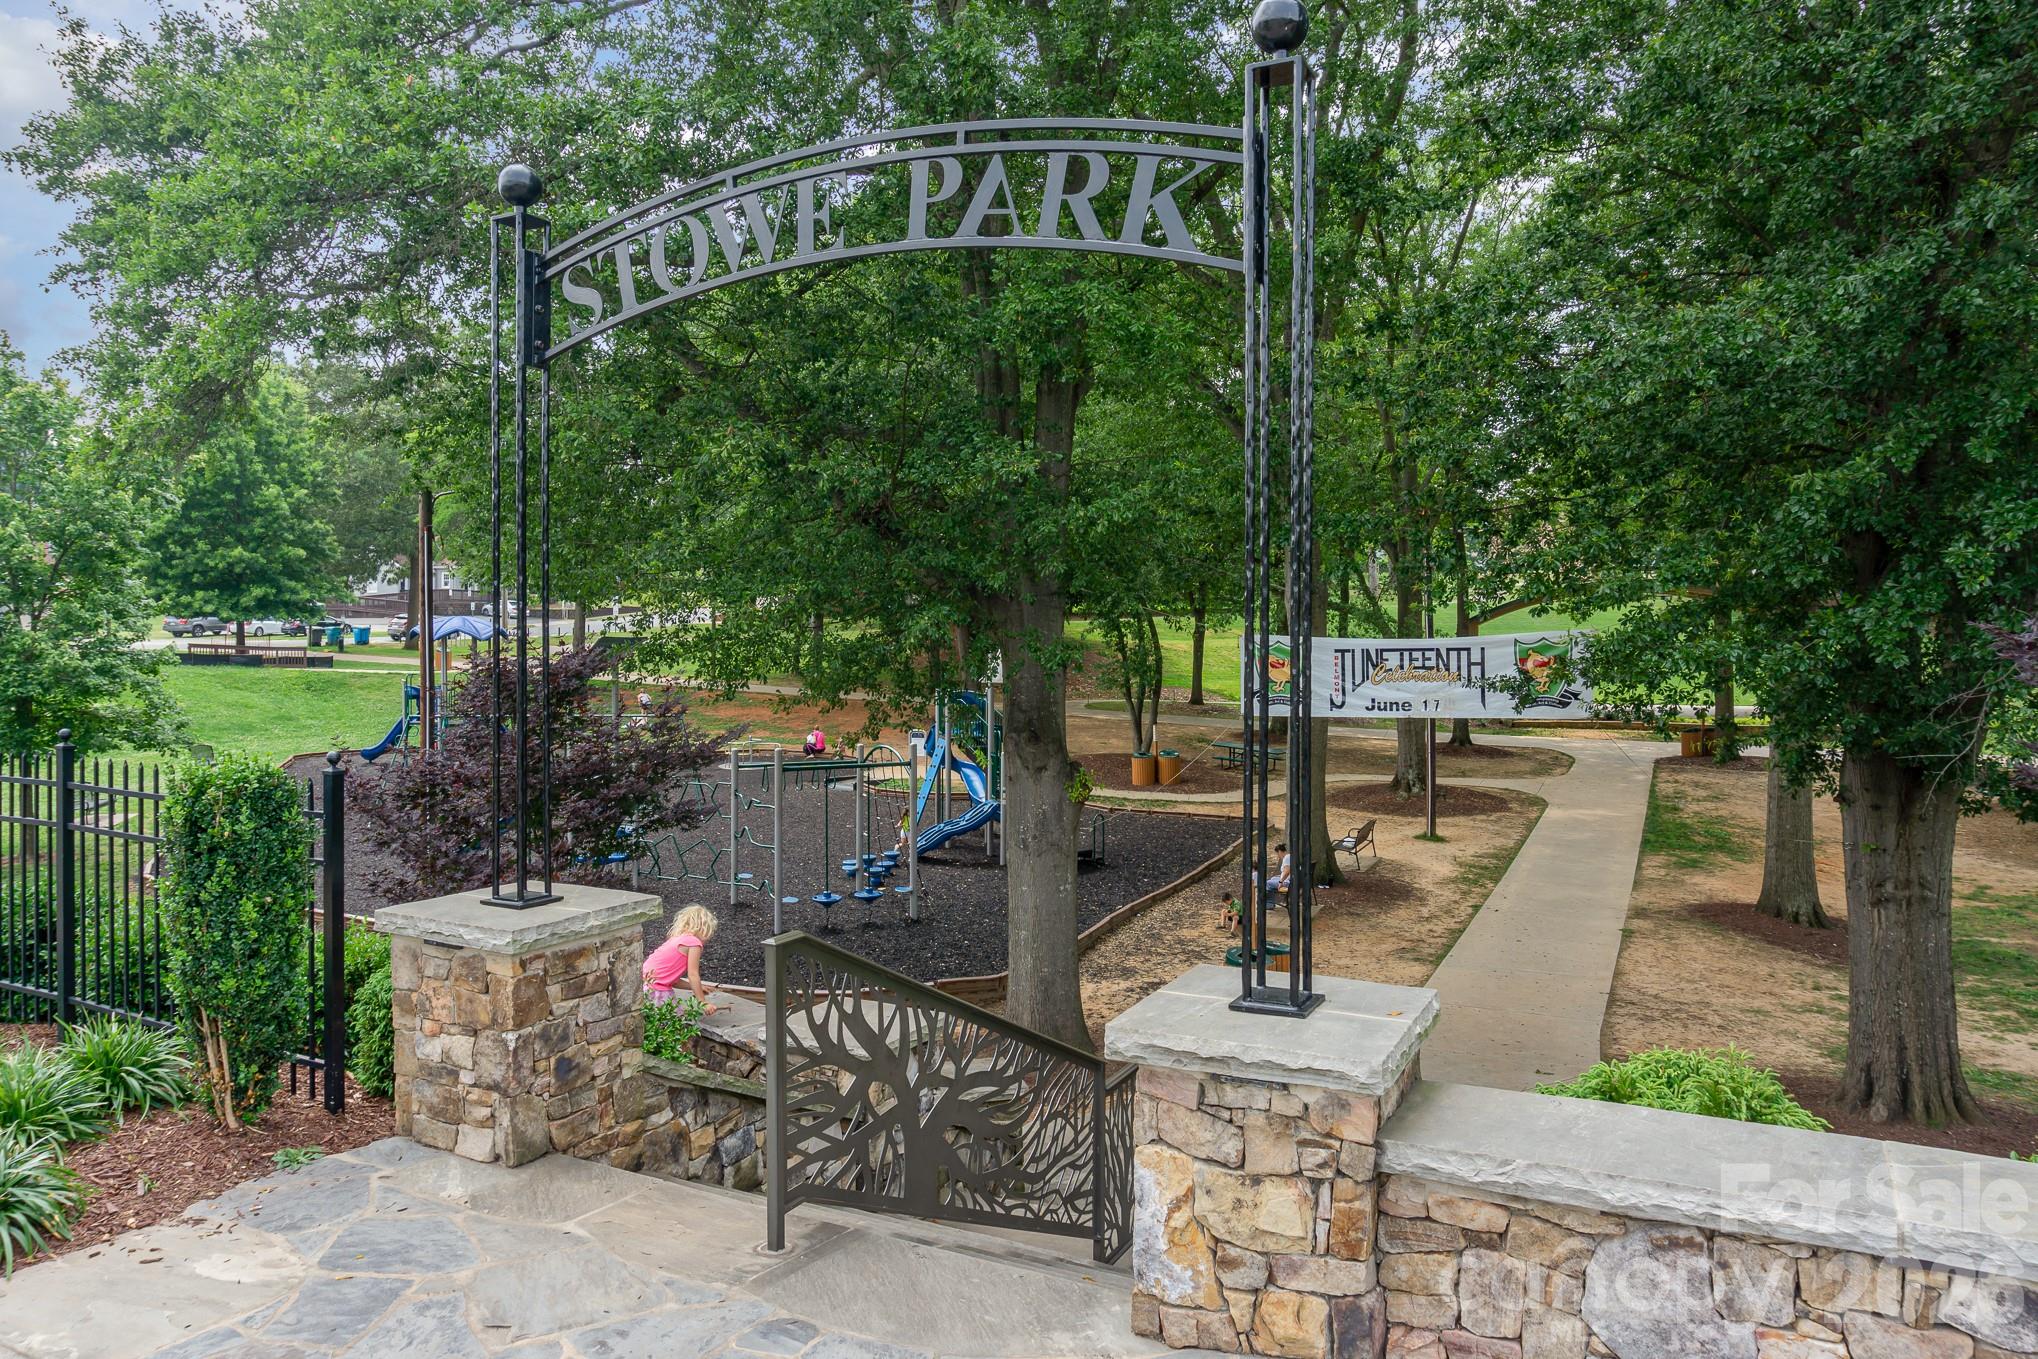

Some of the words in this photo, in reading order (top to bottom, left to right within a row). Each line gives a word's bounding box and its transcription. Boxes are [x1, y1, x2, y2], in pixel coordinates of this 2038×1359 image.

[562, 170, 848, 335] STOWE
[900, 151, 1216, 254] PARK
[1329, 647, 1487, 712] JUNETEENTH
[1333, 655, 1342, 698] BELMONT
[1370, 663, 1461, 686] Celebration
[1365, 698, 1413, 711] June
